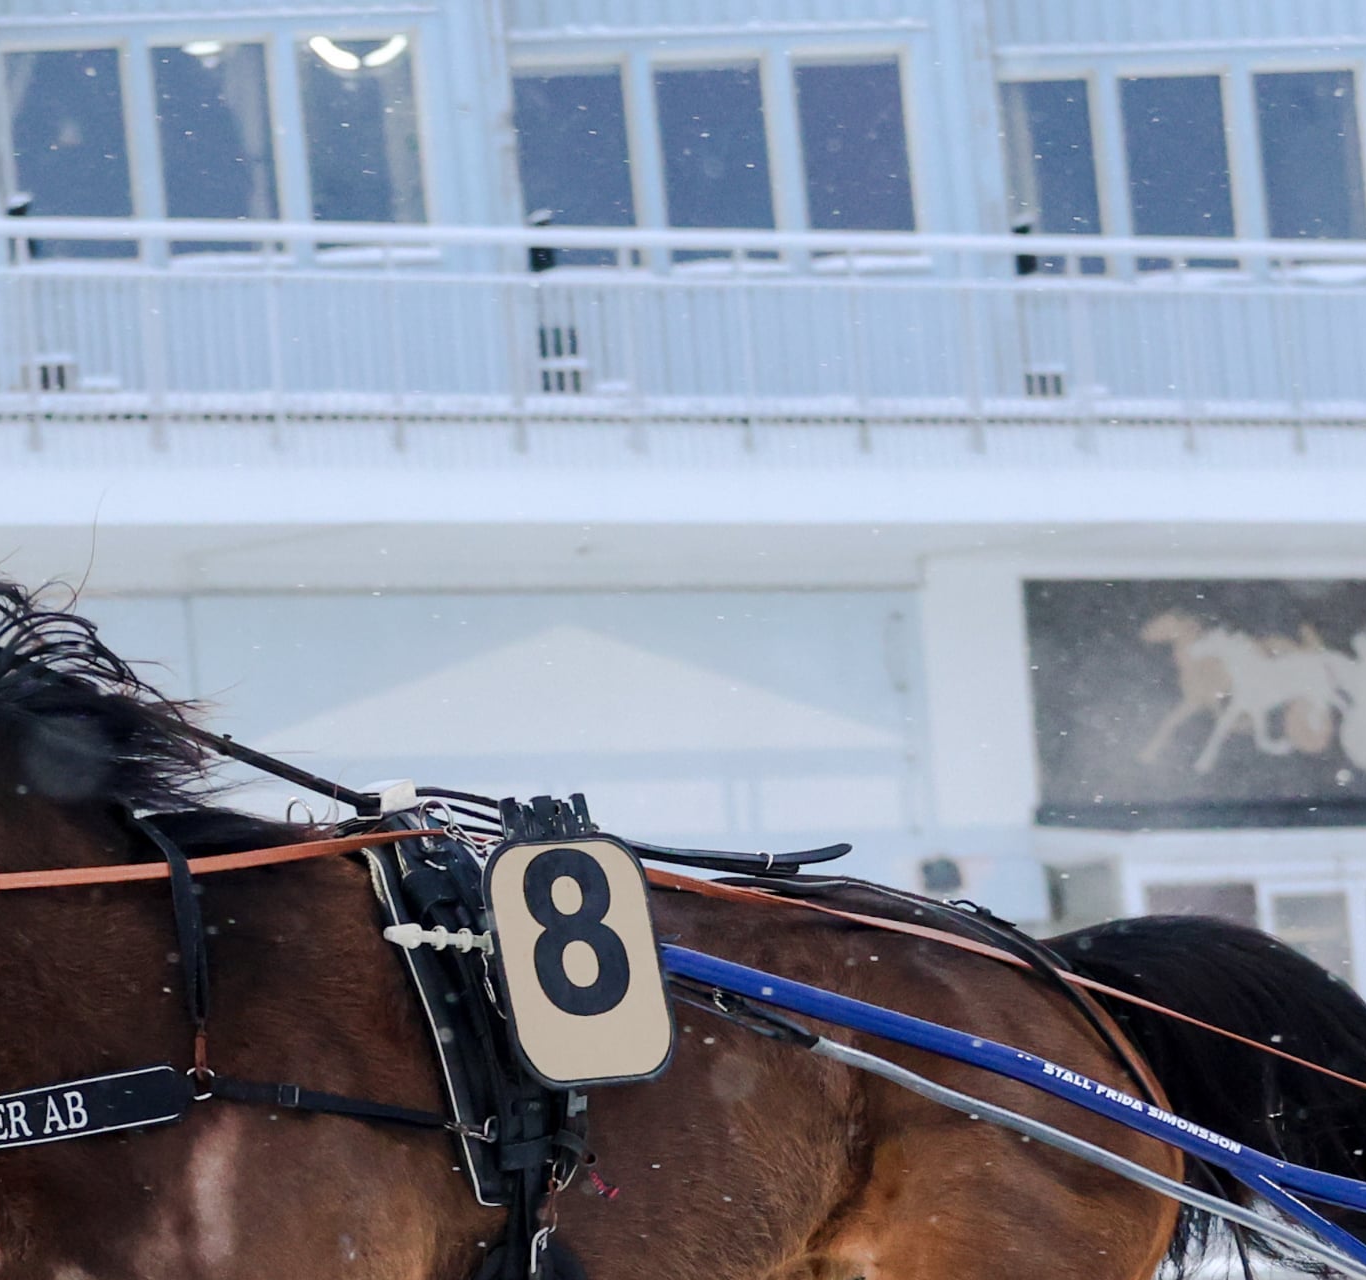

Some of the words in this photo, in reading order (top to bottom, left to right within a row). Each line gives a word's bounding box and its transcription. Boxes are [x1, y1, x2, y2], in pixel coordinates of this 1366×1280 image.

[522, 848, 630, 1017] 8
[42, 1091, 89, 1135] AB
[1042, 1063, 1092, 1091] STALL
[1096, 1084, 1143, 1112] FRIDA
[1147, 1105, 1242, 1154] SIMONSSON
